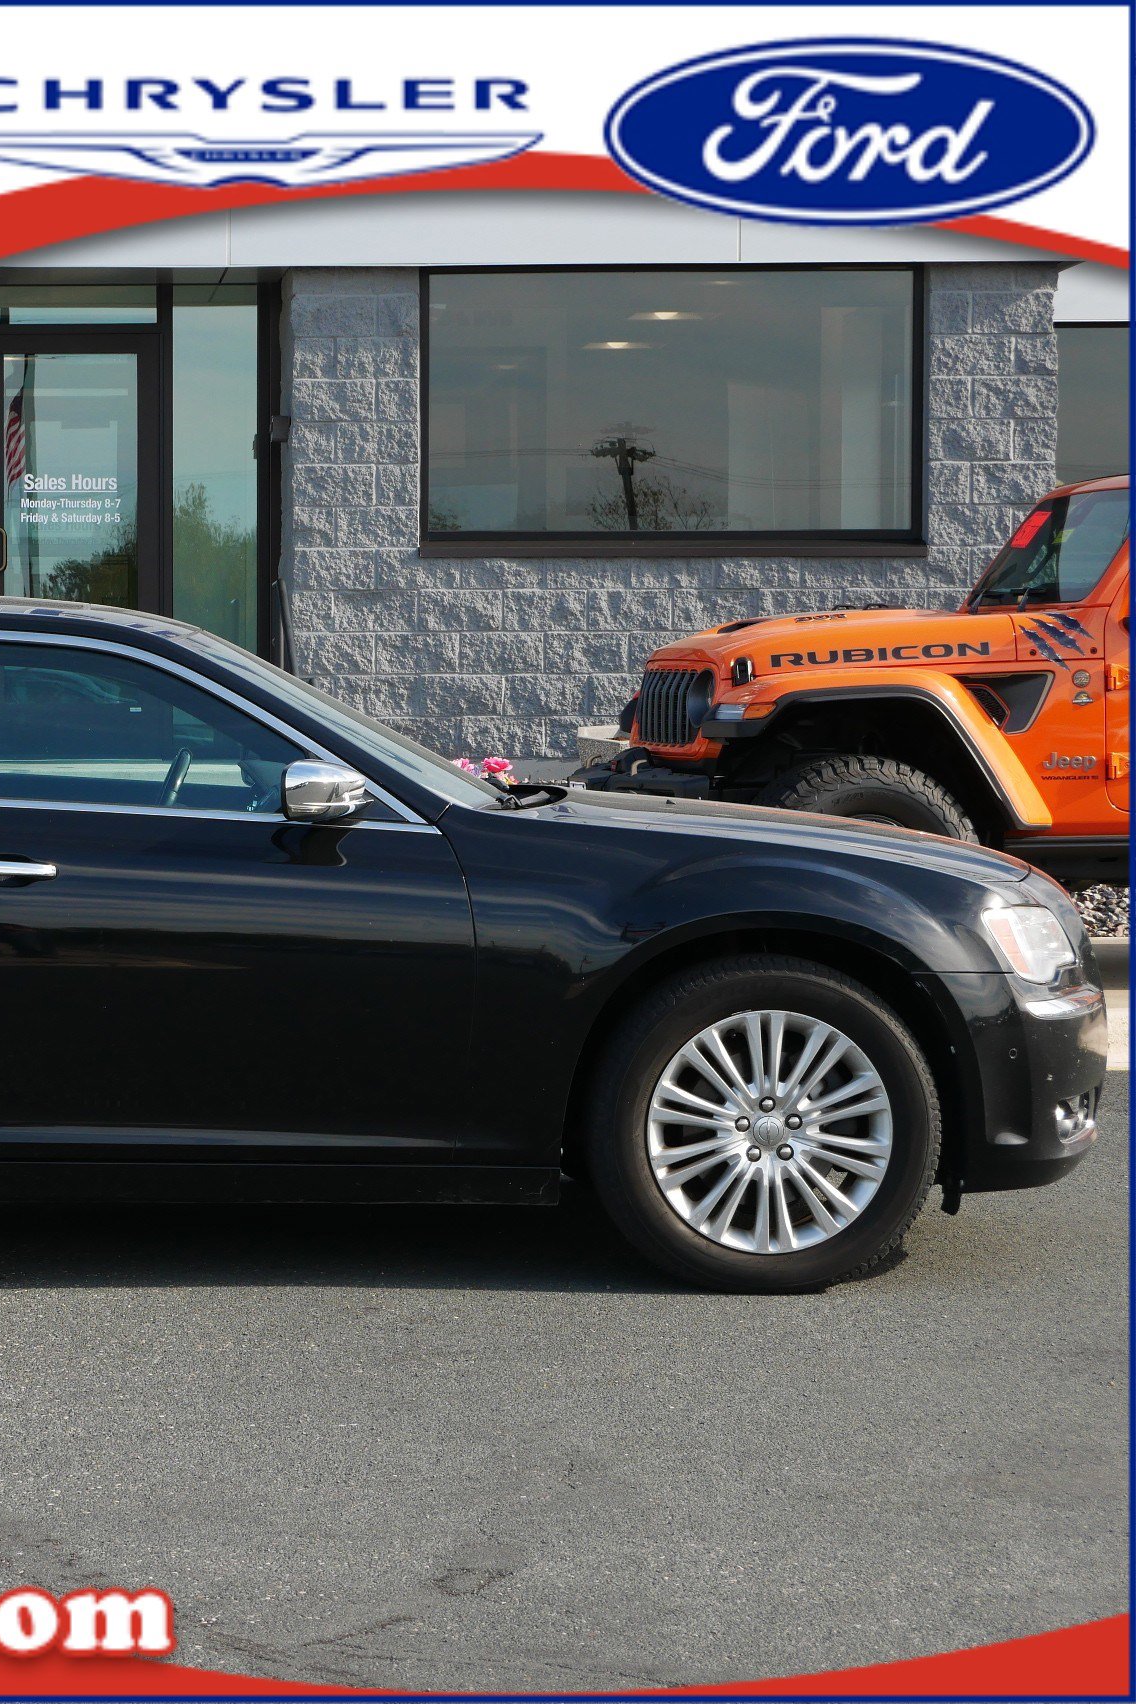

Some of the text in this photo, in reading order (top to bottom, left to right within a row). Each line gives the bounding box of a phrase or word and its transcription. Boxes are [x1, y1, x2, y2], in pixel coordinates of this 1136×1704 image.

[24, 474, 117, 490] Sales Hours
[21, 499, 121, 510] Monday-Thursday 8-7
[21, 513, 120, 524] Friday & Saturday 8-5
[770, 641, 990, 668] RUBICON
[1042, 751, 1097, 772] Jeep
